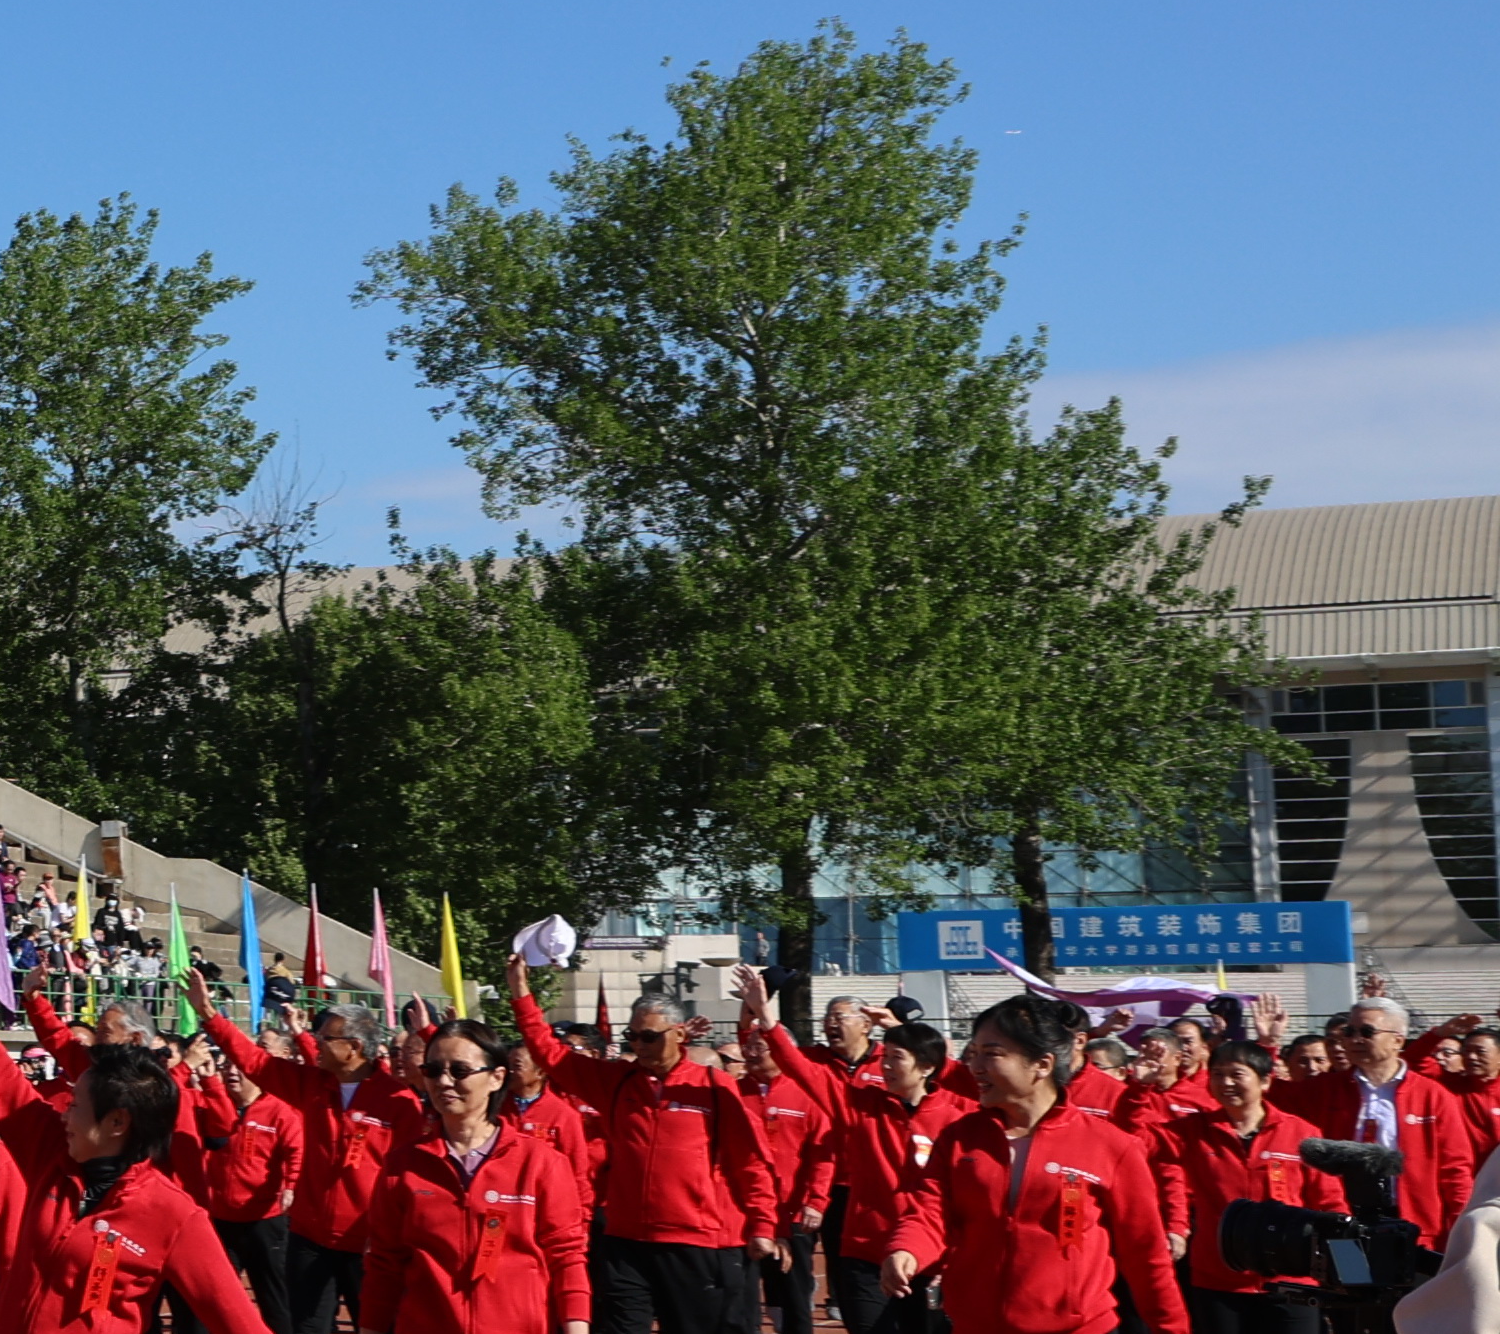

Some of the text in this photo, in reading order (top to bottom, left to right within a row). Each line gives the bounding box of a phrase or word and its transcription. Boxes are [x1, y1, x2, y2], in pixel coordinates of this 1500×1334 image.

[1006, 940, 1304, 958] 承华大学游泳馆周边配套工程
